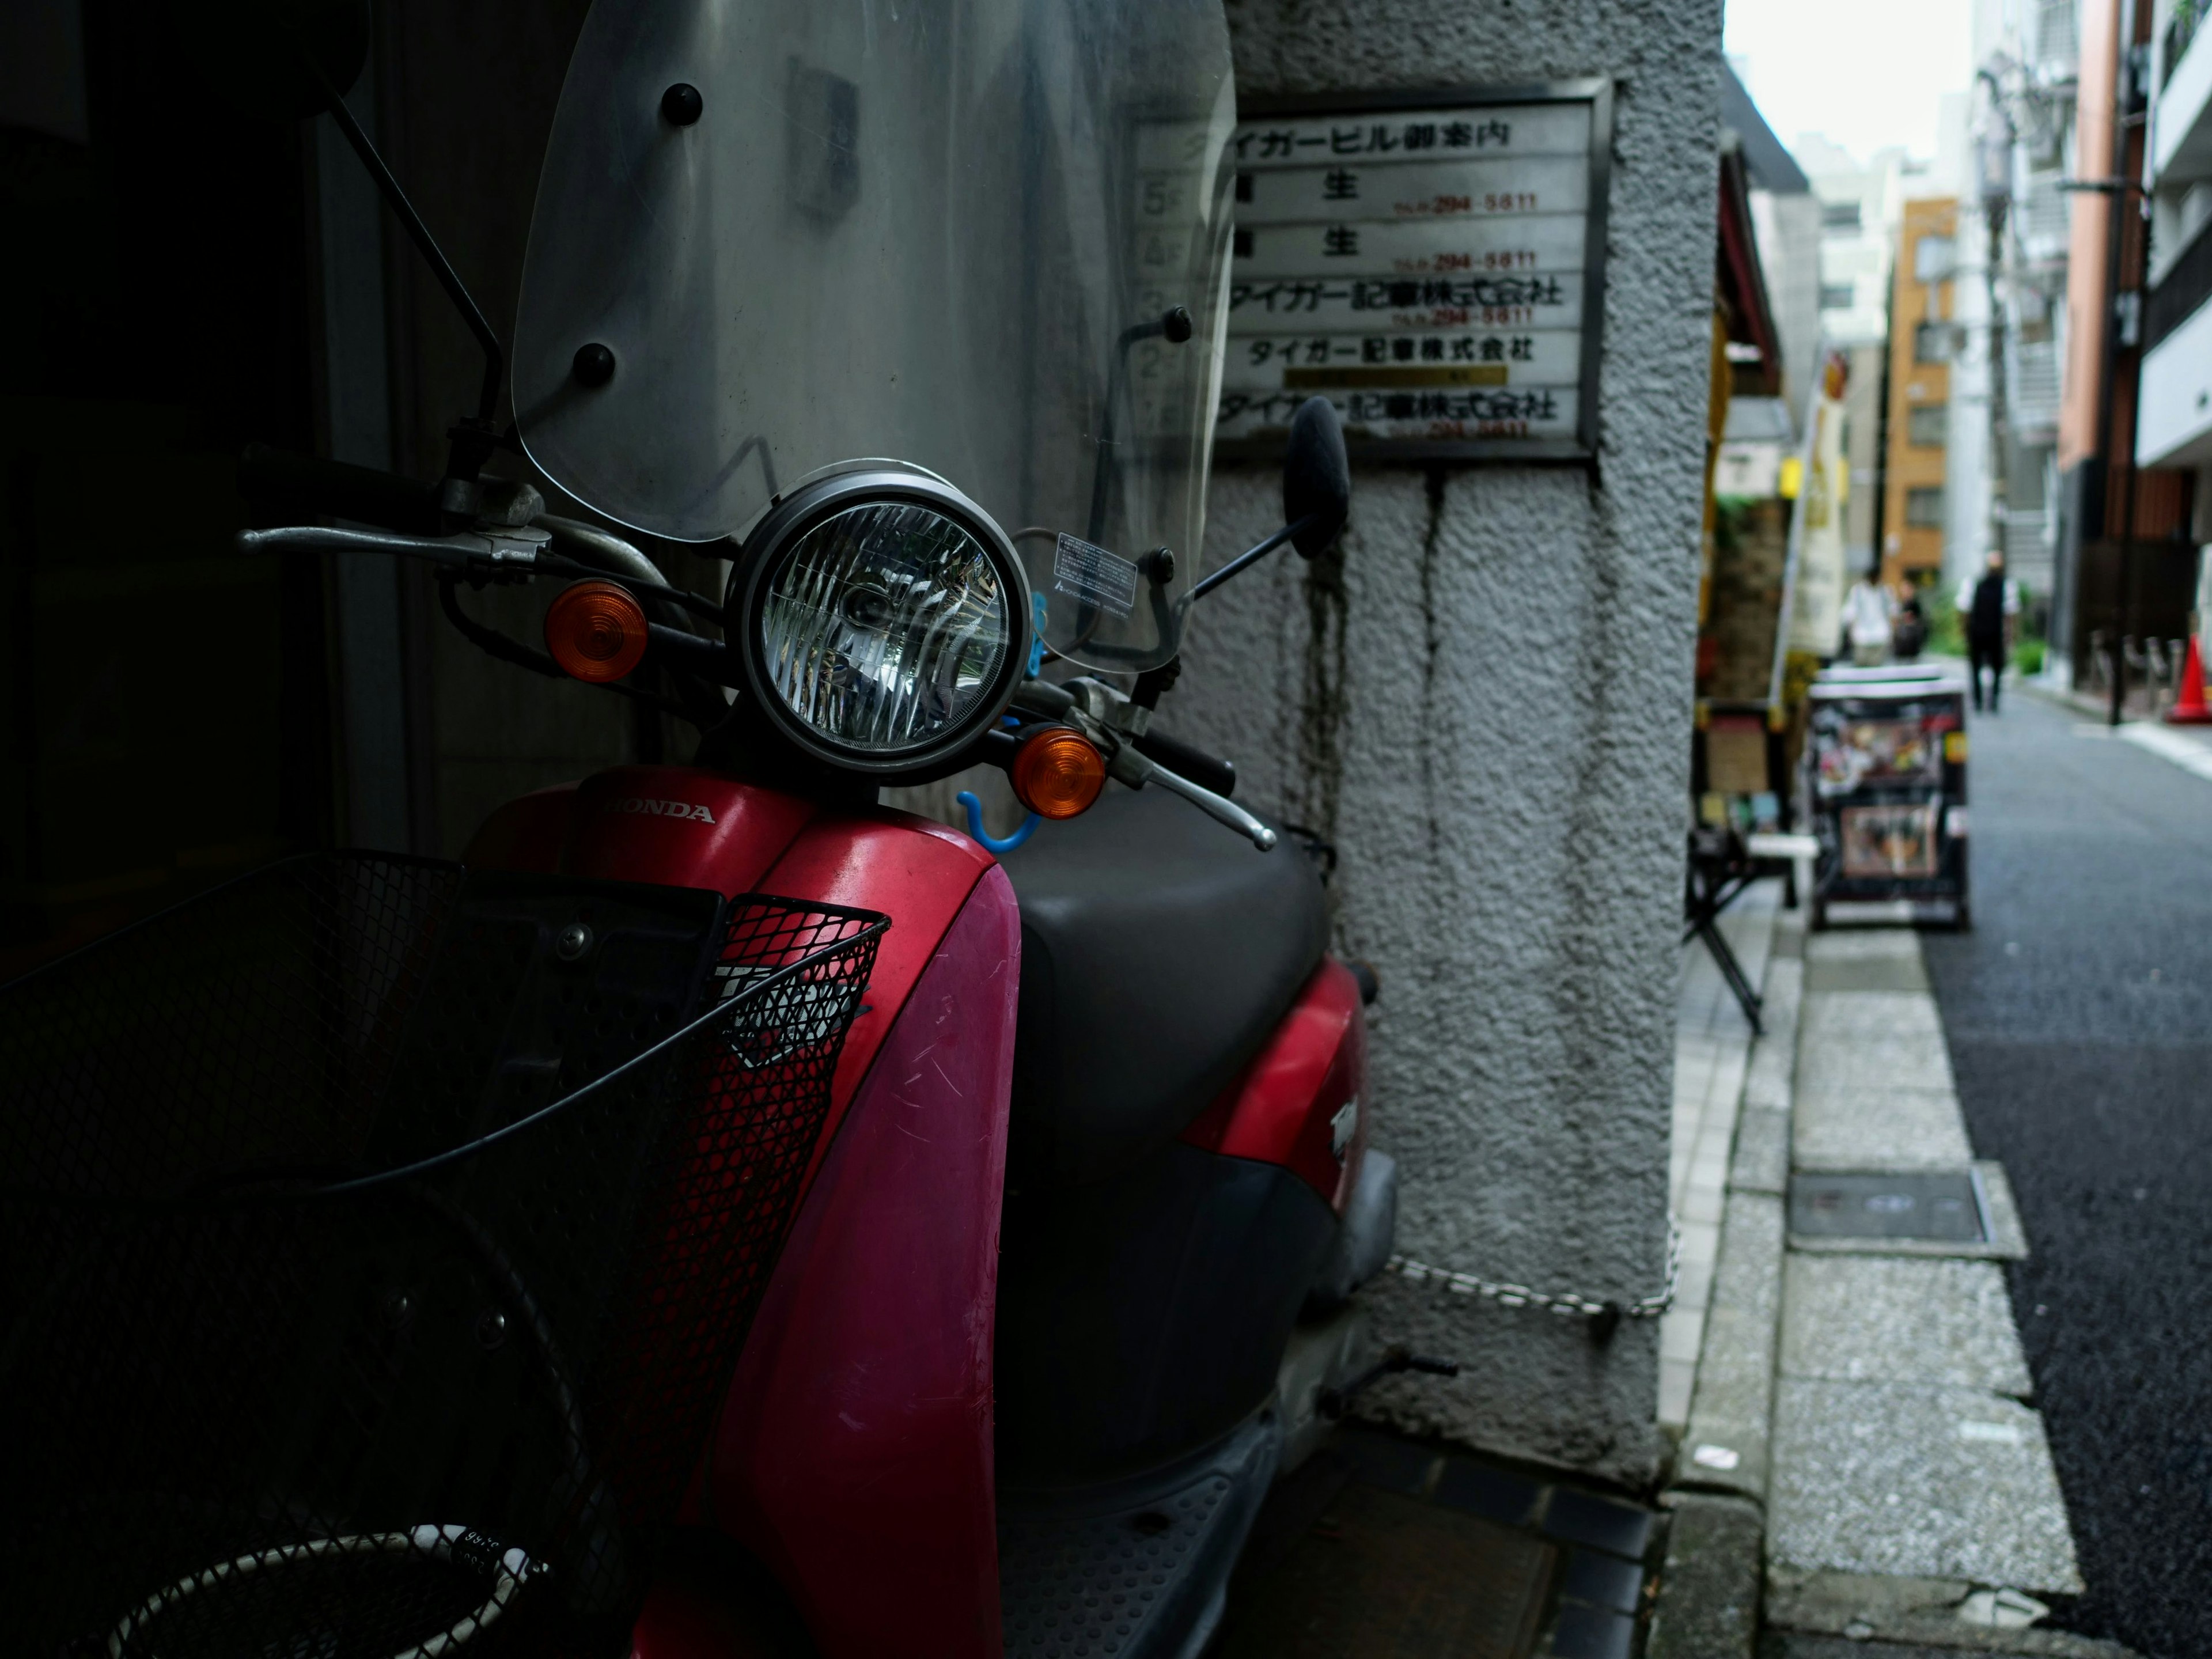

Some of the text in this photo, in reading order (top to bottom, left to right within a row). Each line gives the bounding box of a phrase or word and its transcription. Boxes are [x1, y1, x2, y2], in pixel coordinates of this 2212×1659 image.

[1323, 167, 1358, 199] 生
[1323, 224, 1358, 256] 生
[603, 798, 715, 824] HONDA
